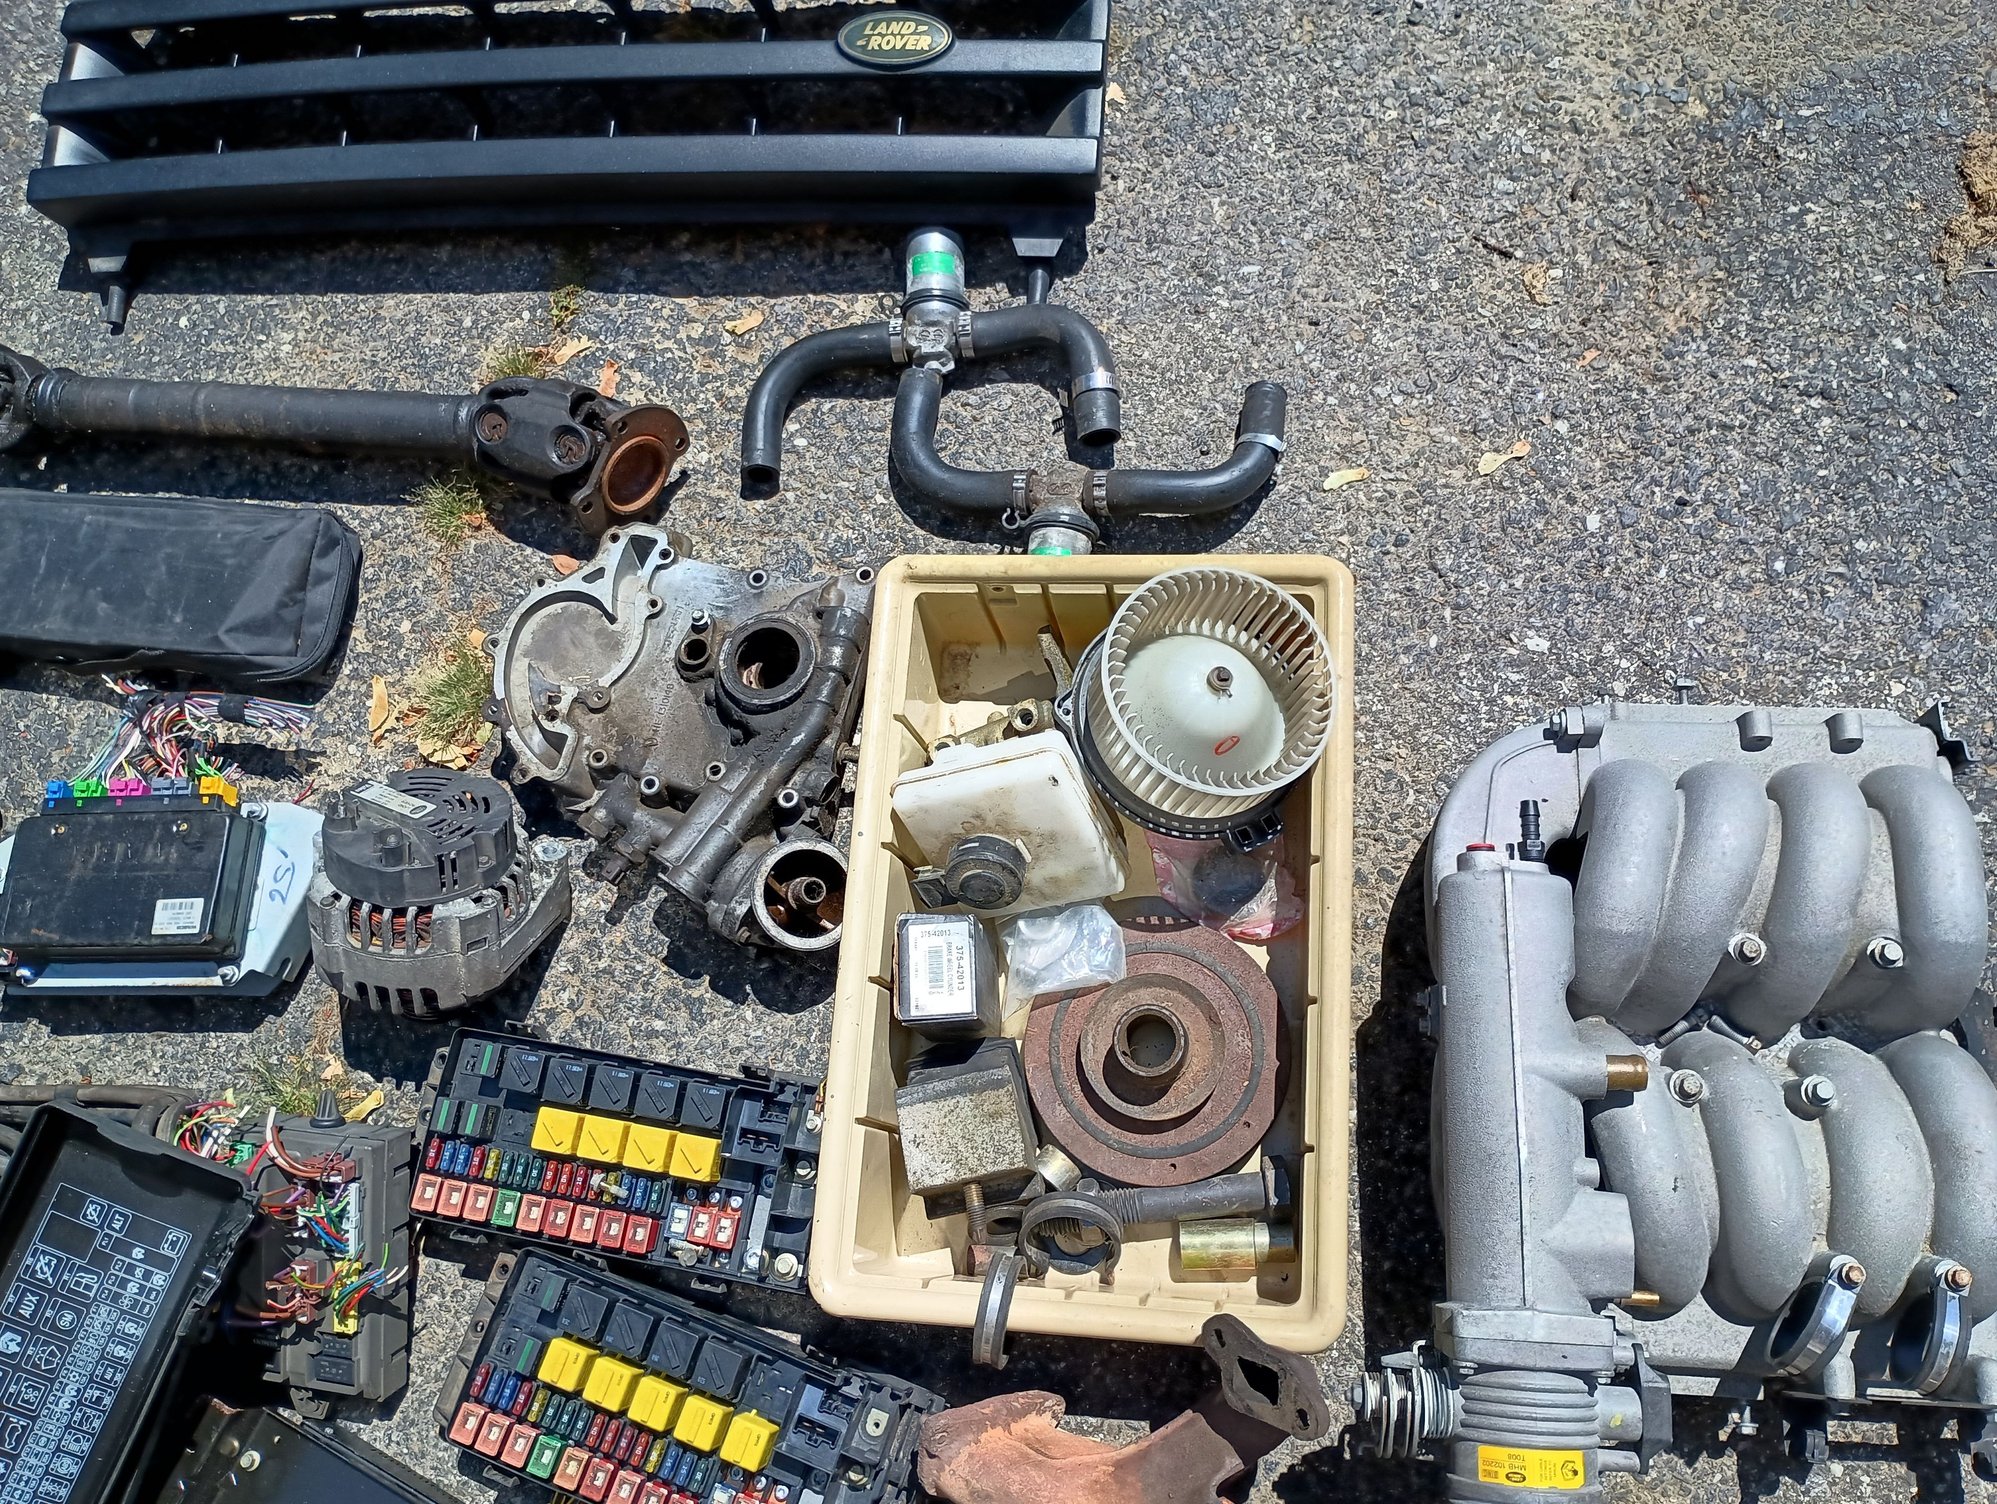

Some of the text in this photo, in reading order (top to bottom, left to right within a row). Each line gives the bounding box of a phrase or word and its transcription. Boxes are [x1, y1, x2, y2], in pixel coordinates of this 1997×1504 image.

[863, 21, 917, 36] LAND
[866, 35, 932, 50] ROVER
[921, 929, 951, 938] 375-42013
[956, 946, 965, 991] 375-42013
[111, 1214, 126, 1231] ALT
[18, 1292, 40, 1319] AUX
[60, 1313, 73, 1327] SM
[104, 1367, 115, 1380] AUX
[1481, 1460, 1506, 1469] 102202
